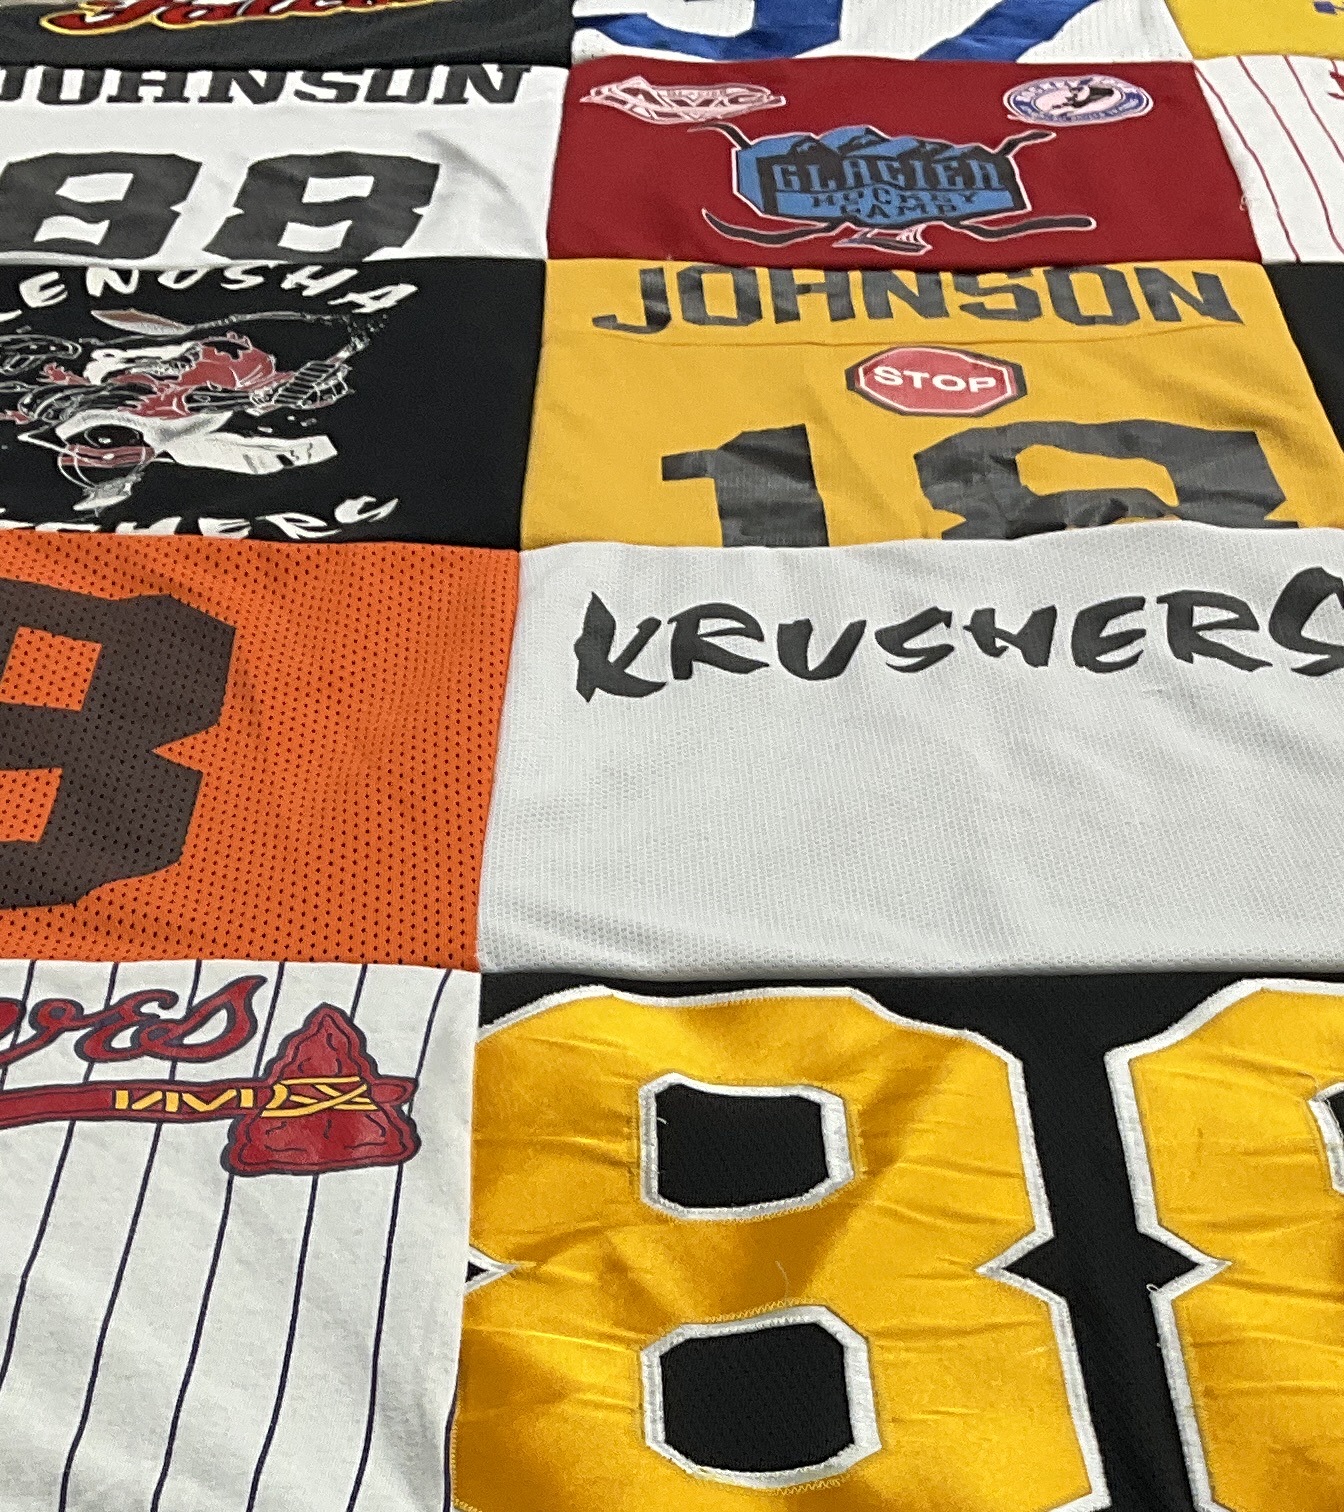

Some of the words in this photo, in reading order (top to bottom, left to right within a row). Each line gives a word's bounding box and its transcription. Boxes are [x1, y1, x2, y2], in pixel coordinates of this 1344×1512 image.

[771, 157, 1007, 192] GLACIER
[592, 262, 1245, 335] JOHNSON
[873, 345, 997, 394] STOP
